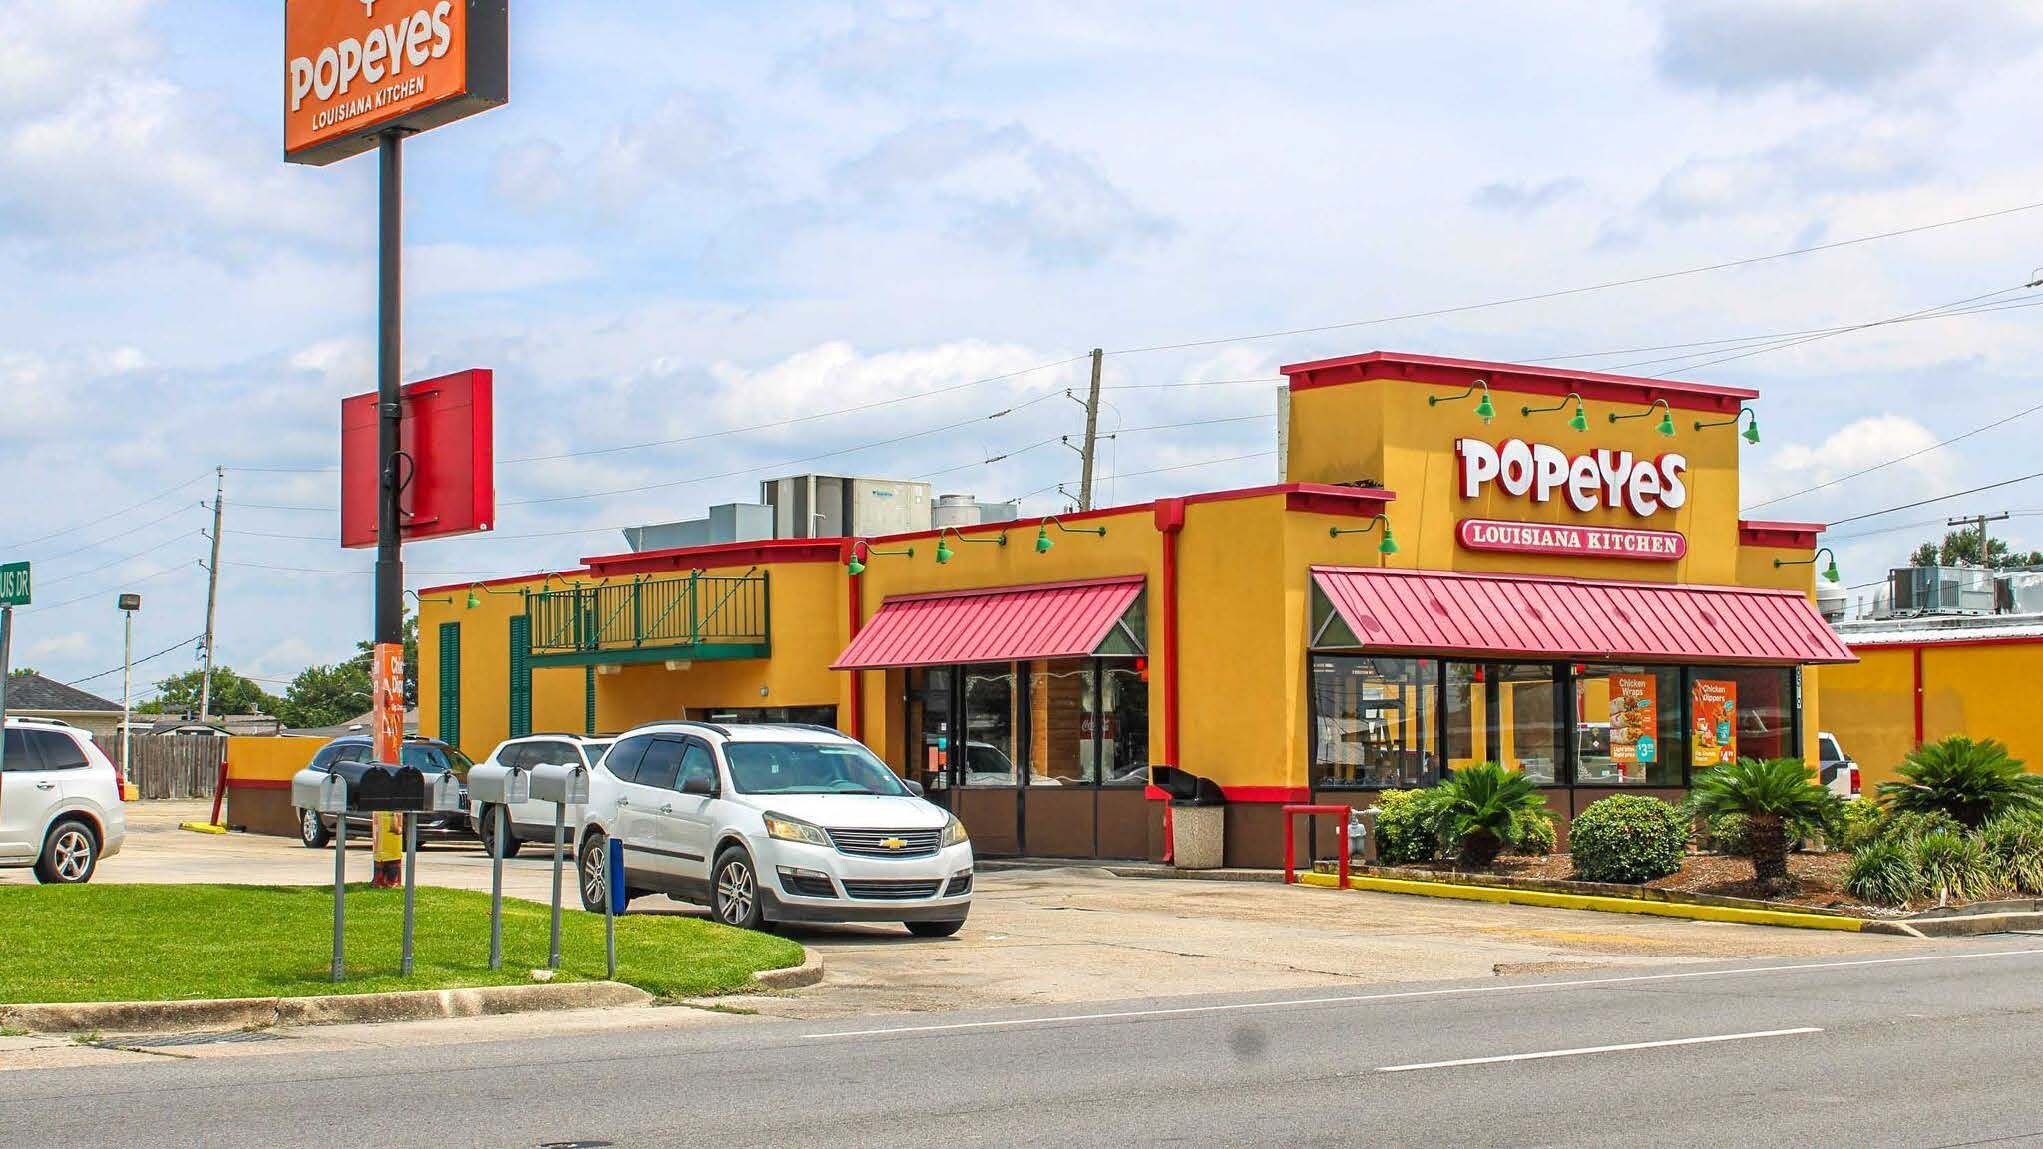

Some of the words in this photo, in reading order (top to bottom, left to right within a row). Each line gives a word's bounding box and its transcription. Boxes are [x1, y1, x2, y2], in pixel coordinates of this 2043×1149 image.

[312, 95, 372, 131] LOUISIANA
[375, 75, 425, 110] KITCHEN
[1473, 525, 1582, 548] LOUISIANA
[1587, 532, 1678, 554] KITCHEN
[16, 570, 29, 596] DR
[1619, 678, 1646, 688] Chicken
[1621, 687, 1644, 697] Wraps
[1702, 685, 1726, 694] Chicken
